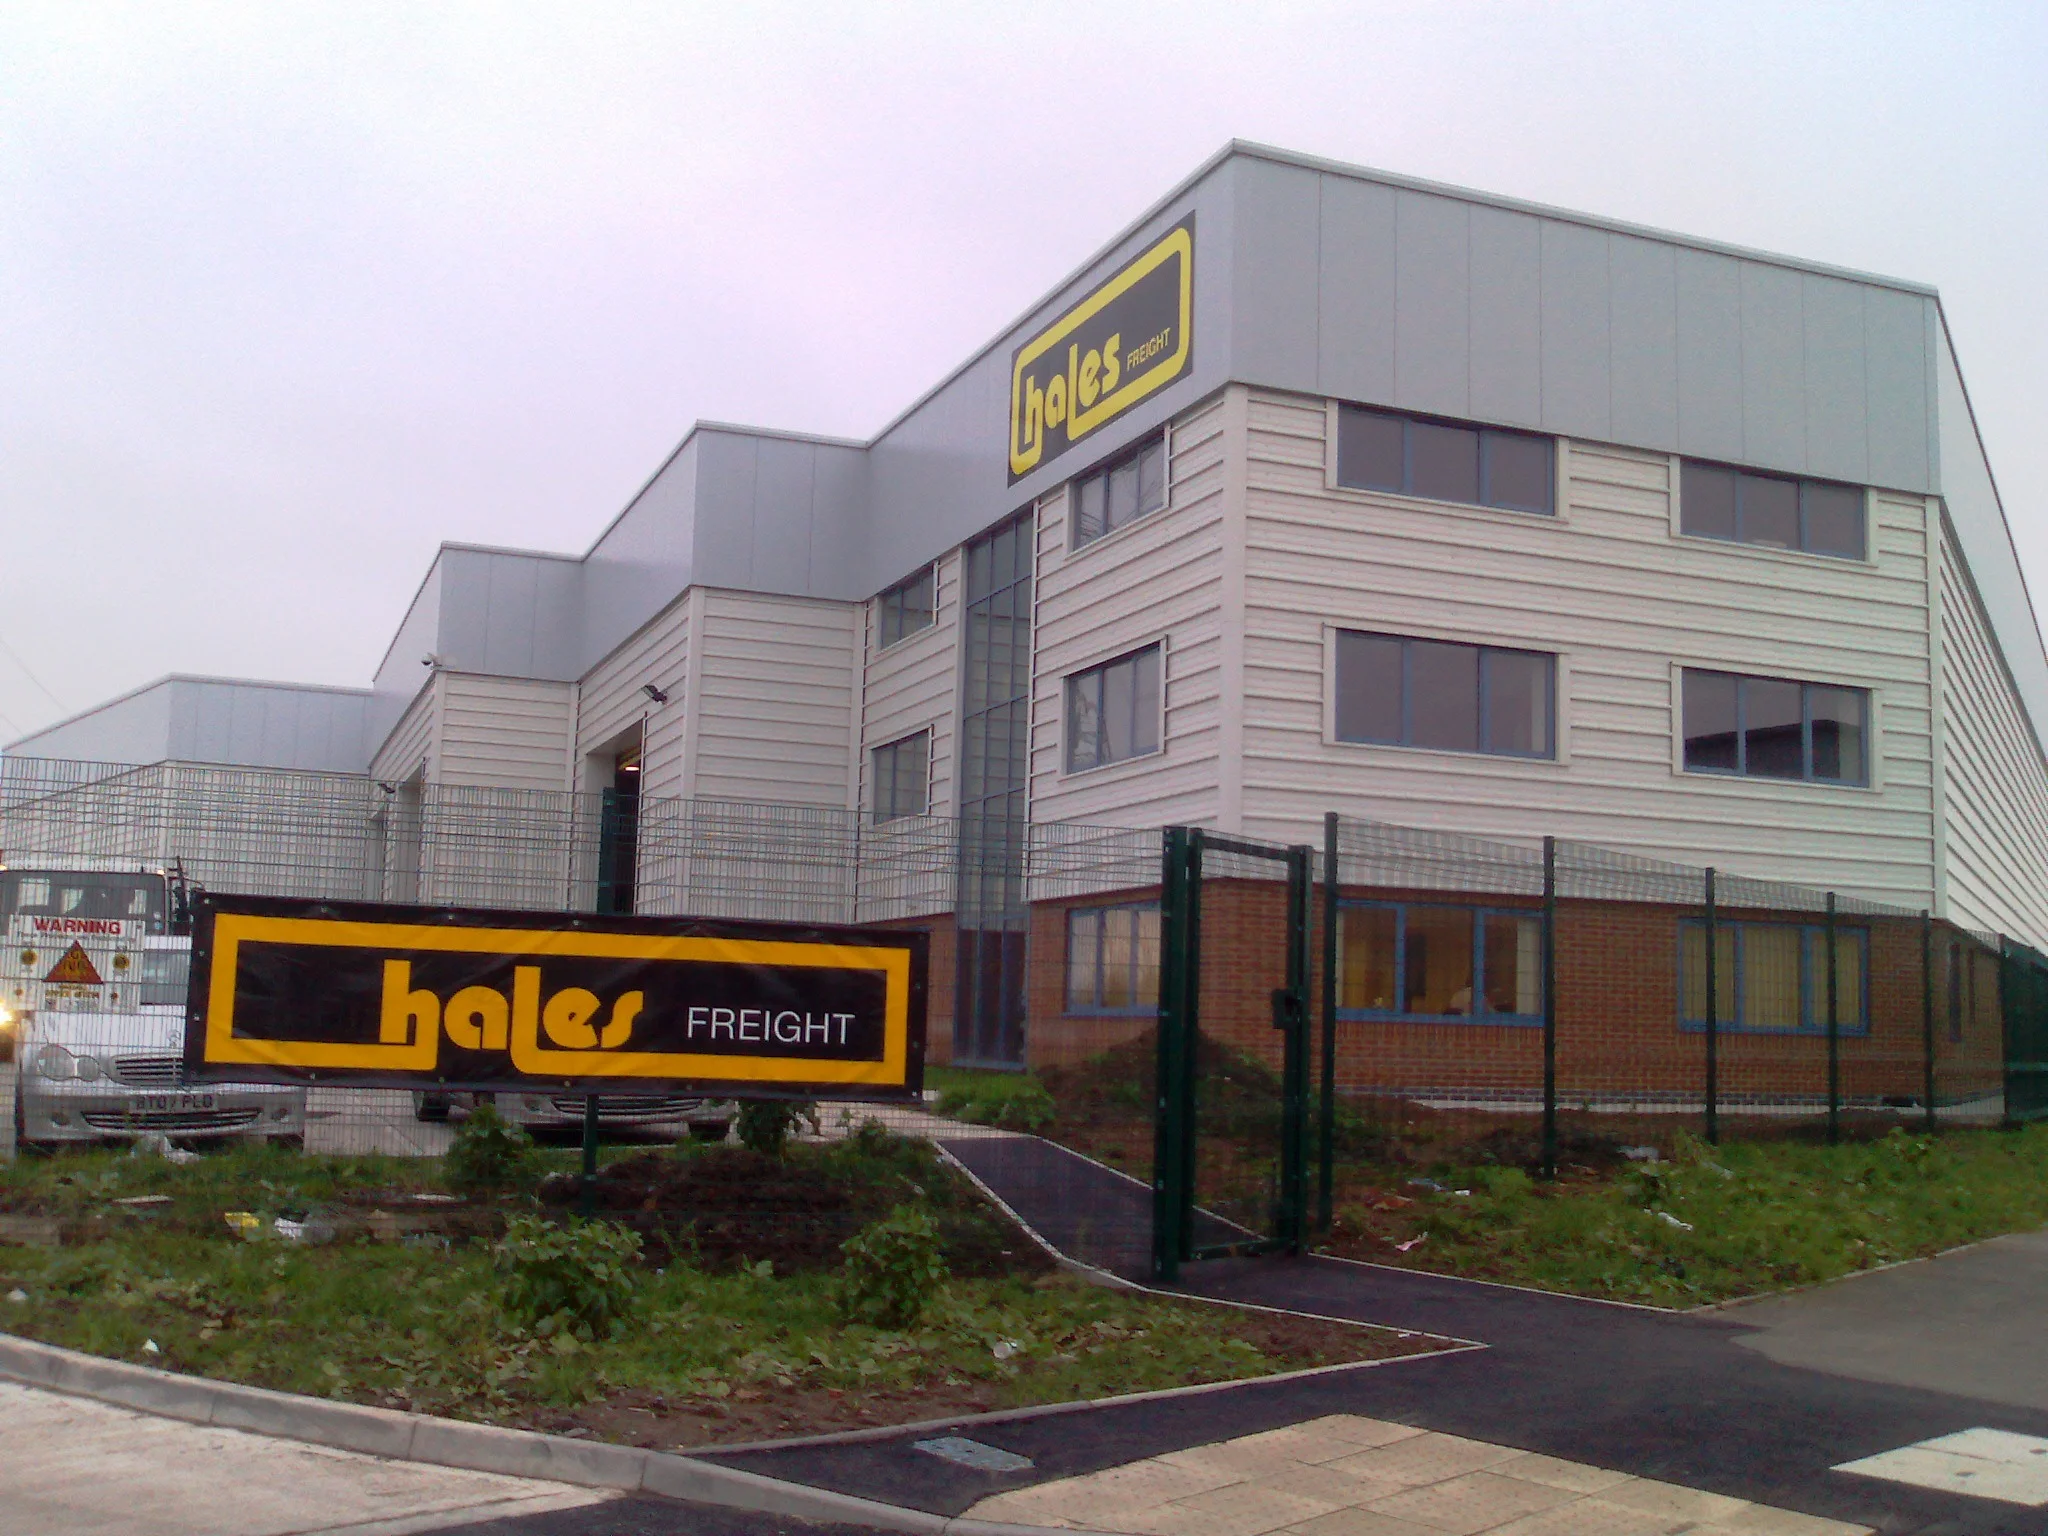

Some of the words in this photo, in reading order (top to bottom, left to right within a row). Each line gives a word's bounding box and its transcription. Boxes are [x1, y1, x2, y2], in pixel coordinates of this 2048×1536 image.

[1022, 333, 1120, 455] hales
[1126, 327, 1170, 372] FREIGHT
[34, 917, 121, 935] WARNING
[379, 959, 643, 1070] hales
[687, 1007, 856, 1044] FREIGHT
